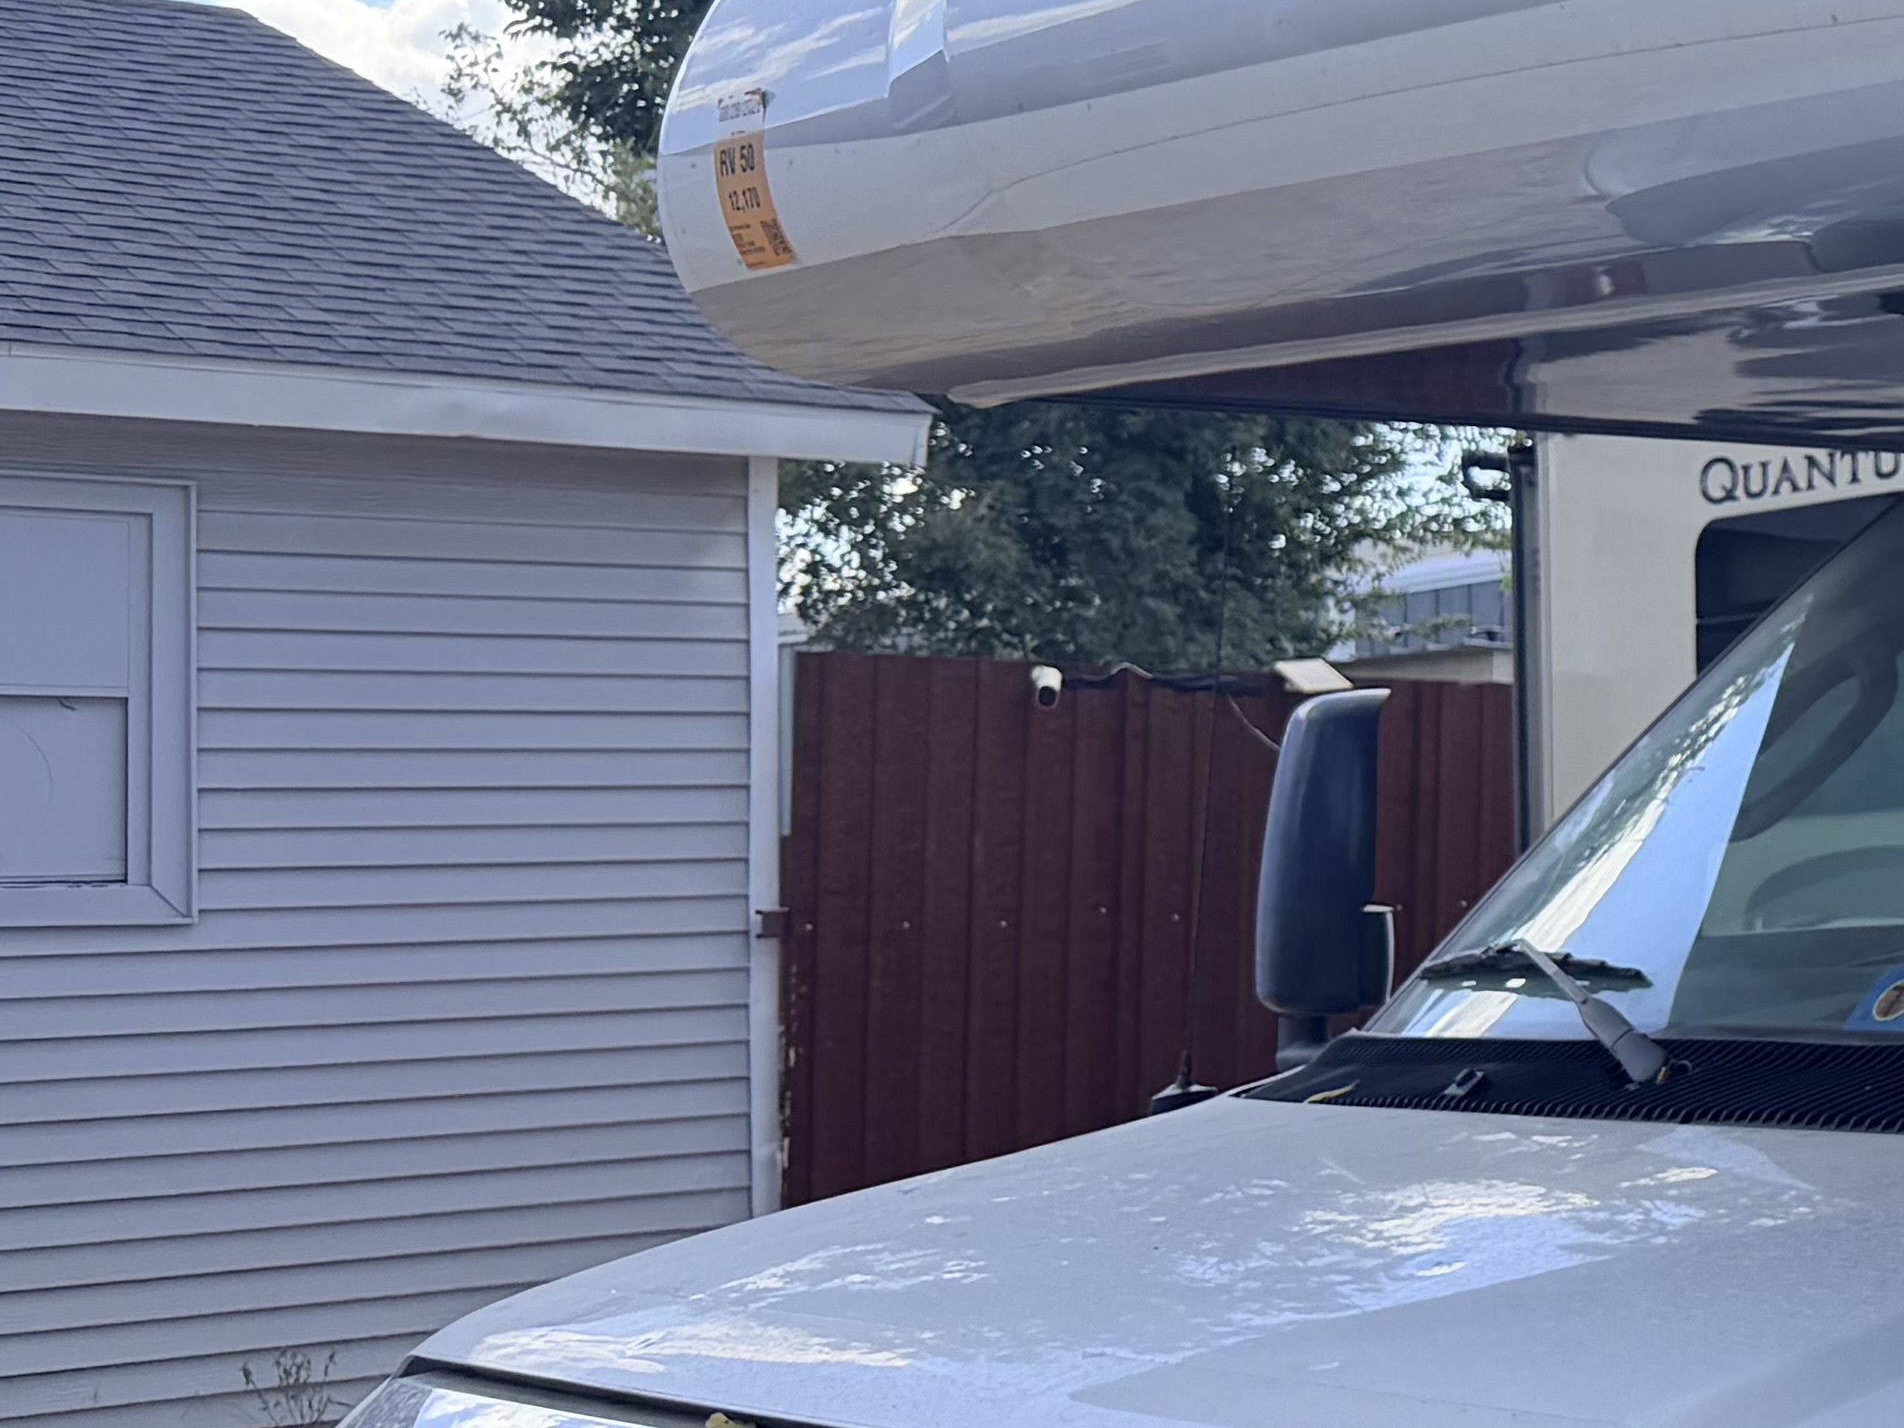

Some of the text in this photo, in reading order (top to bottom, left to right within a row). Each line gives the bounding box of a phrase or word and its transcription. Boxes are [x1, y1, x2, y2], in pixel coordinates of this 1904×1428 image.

[719, 143, 755, 177] RV 50
[728, 186, 761, 213] 12,170
